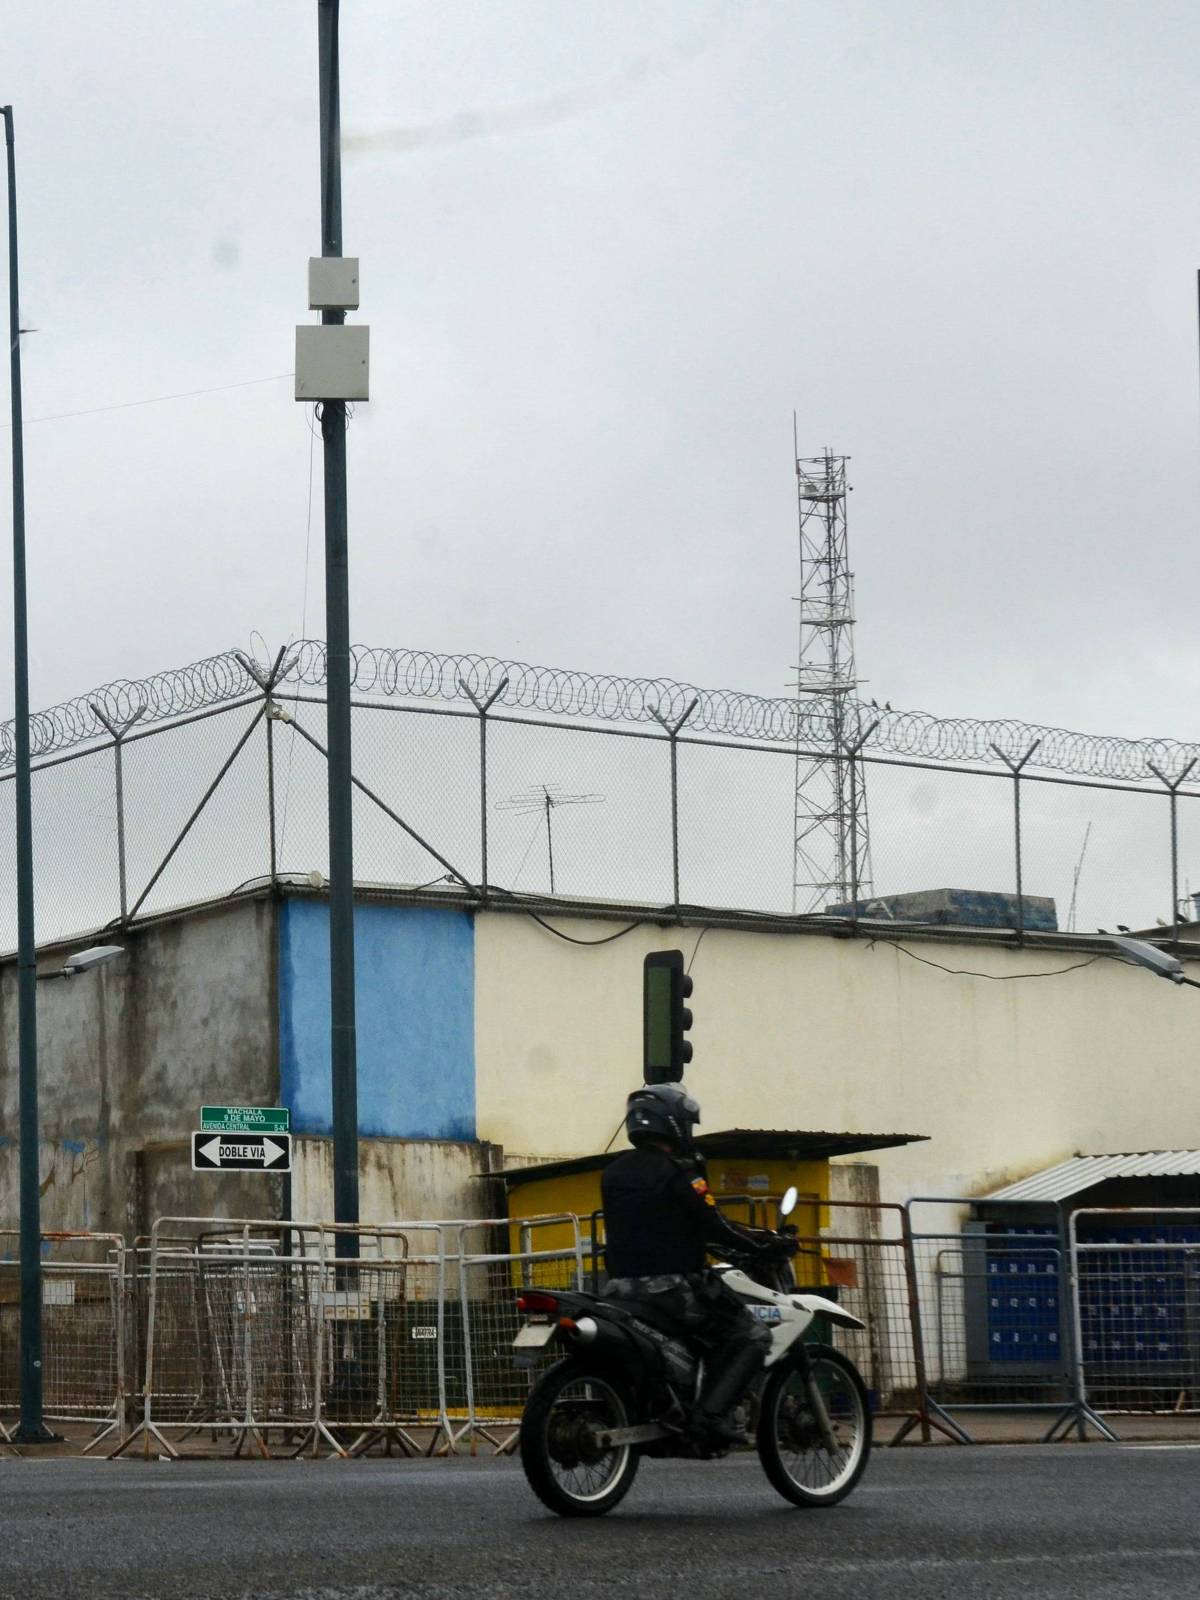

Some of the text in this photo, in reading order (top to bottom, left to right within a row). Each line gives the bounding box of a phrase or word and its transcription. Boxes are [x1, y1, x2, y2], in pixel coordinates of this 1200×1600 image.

[243, 1114, 266, 1122] MAYO
[202, 1122, 225, 1130] AVENIDA
[226, 1123, 250, 1131] CENTRAL
[219, 1146, 266, 1158] DOBLE VIA
